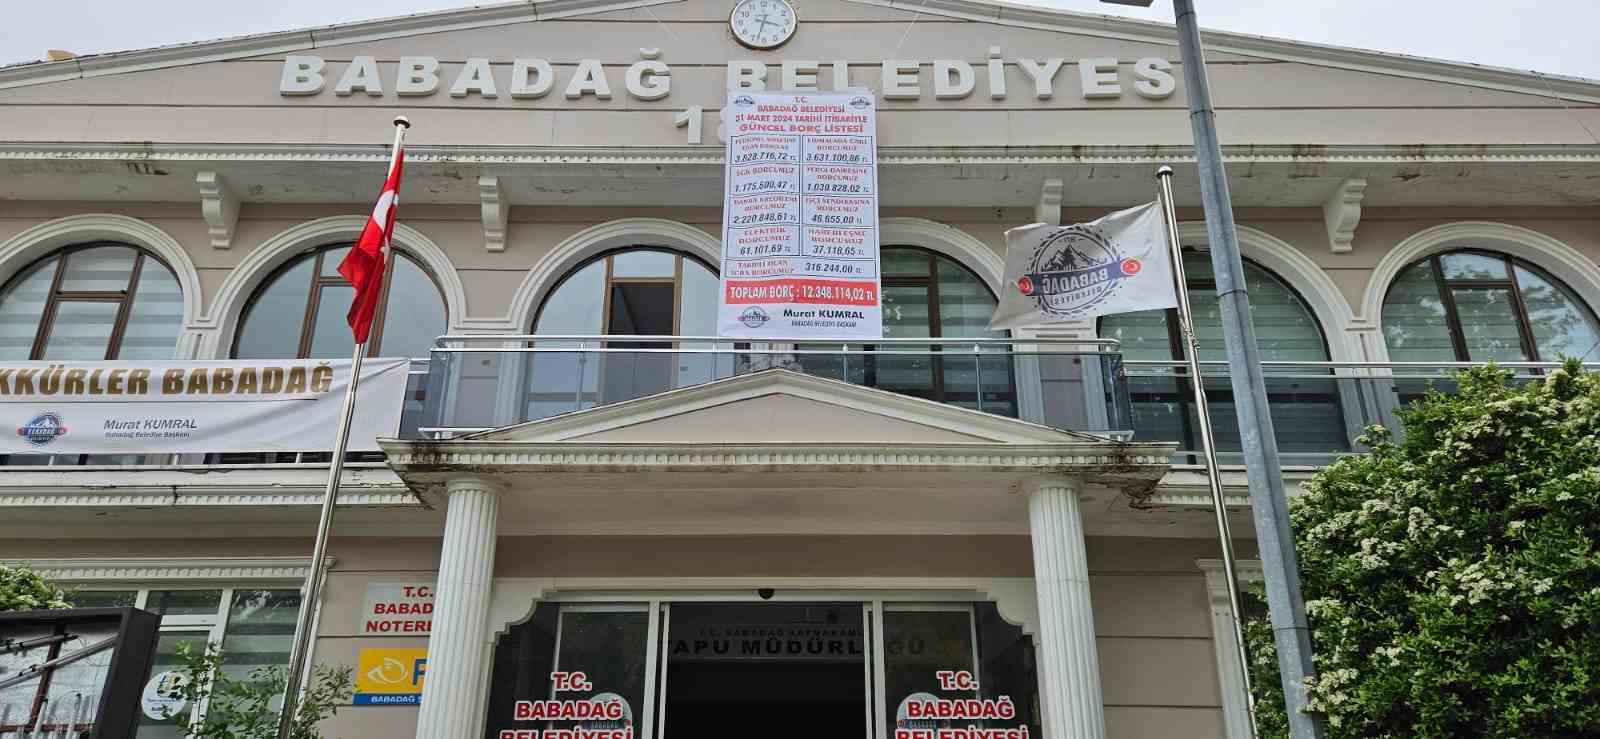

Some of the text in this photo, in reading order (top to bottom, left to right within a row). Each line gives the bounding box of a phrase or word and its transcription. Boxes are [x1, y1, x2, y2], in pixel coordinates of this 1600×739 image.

[279, 47, 672, 101] BABADAĞ
[757, 104, 845, 113] BABADAĞ BELEDİYESİ
[746, 114, 770, 122] MART
[773, 114, 792, 122] 2024
[795, 114, 822, 123] TARİHİ
[740, 122, 863, 134] GÜNCEL BORÇ LİSTESİ
[735, 181, 788, 193] 1.175.500,47
[807, 183, 860, 193] 1.030.828,02
[733, 213, 788, 224] 2.220.848,61
[811, 214, 854, 224] 46.655,00
[740, 243, 782, 255] 61.101,69
[813, 245, 856, 256] 37.118,65
[805, 262, 853, 274] 316.244,00
[729, 286, 767, 298] TOPLAM
[769, 285, 795, 301] BORÇ
[802, 285, 864, 302] 12.348.114,02
[866, 290, 875, 300] TL
[784, 308, 865, 319] Murat KUMRAL
[161, 361, 333, 395] BABADAĞ
[103, 418, 198, 430] Murat KUMRAL
[403, 586, 434, 598] T.C.
[552, 672, 592, 691] T.C.
[937, 671, 978, 690] T.C.
[515, 699, 623, 719] BABADAĞ
[907, 695, 1015, 719] BABADAĞ
